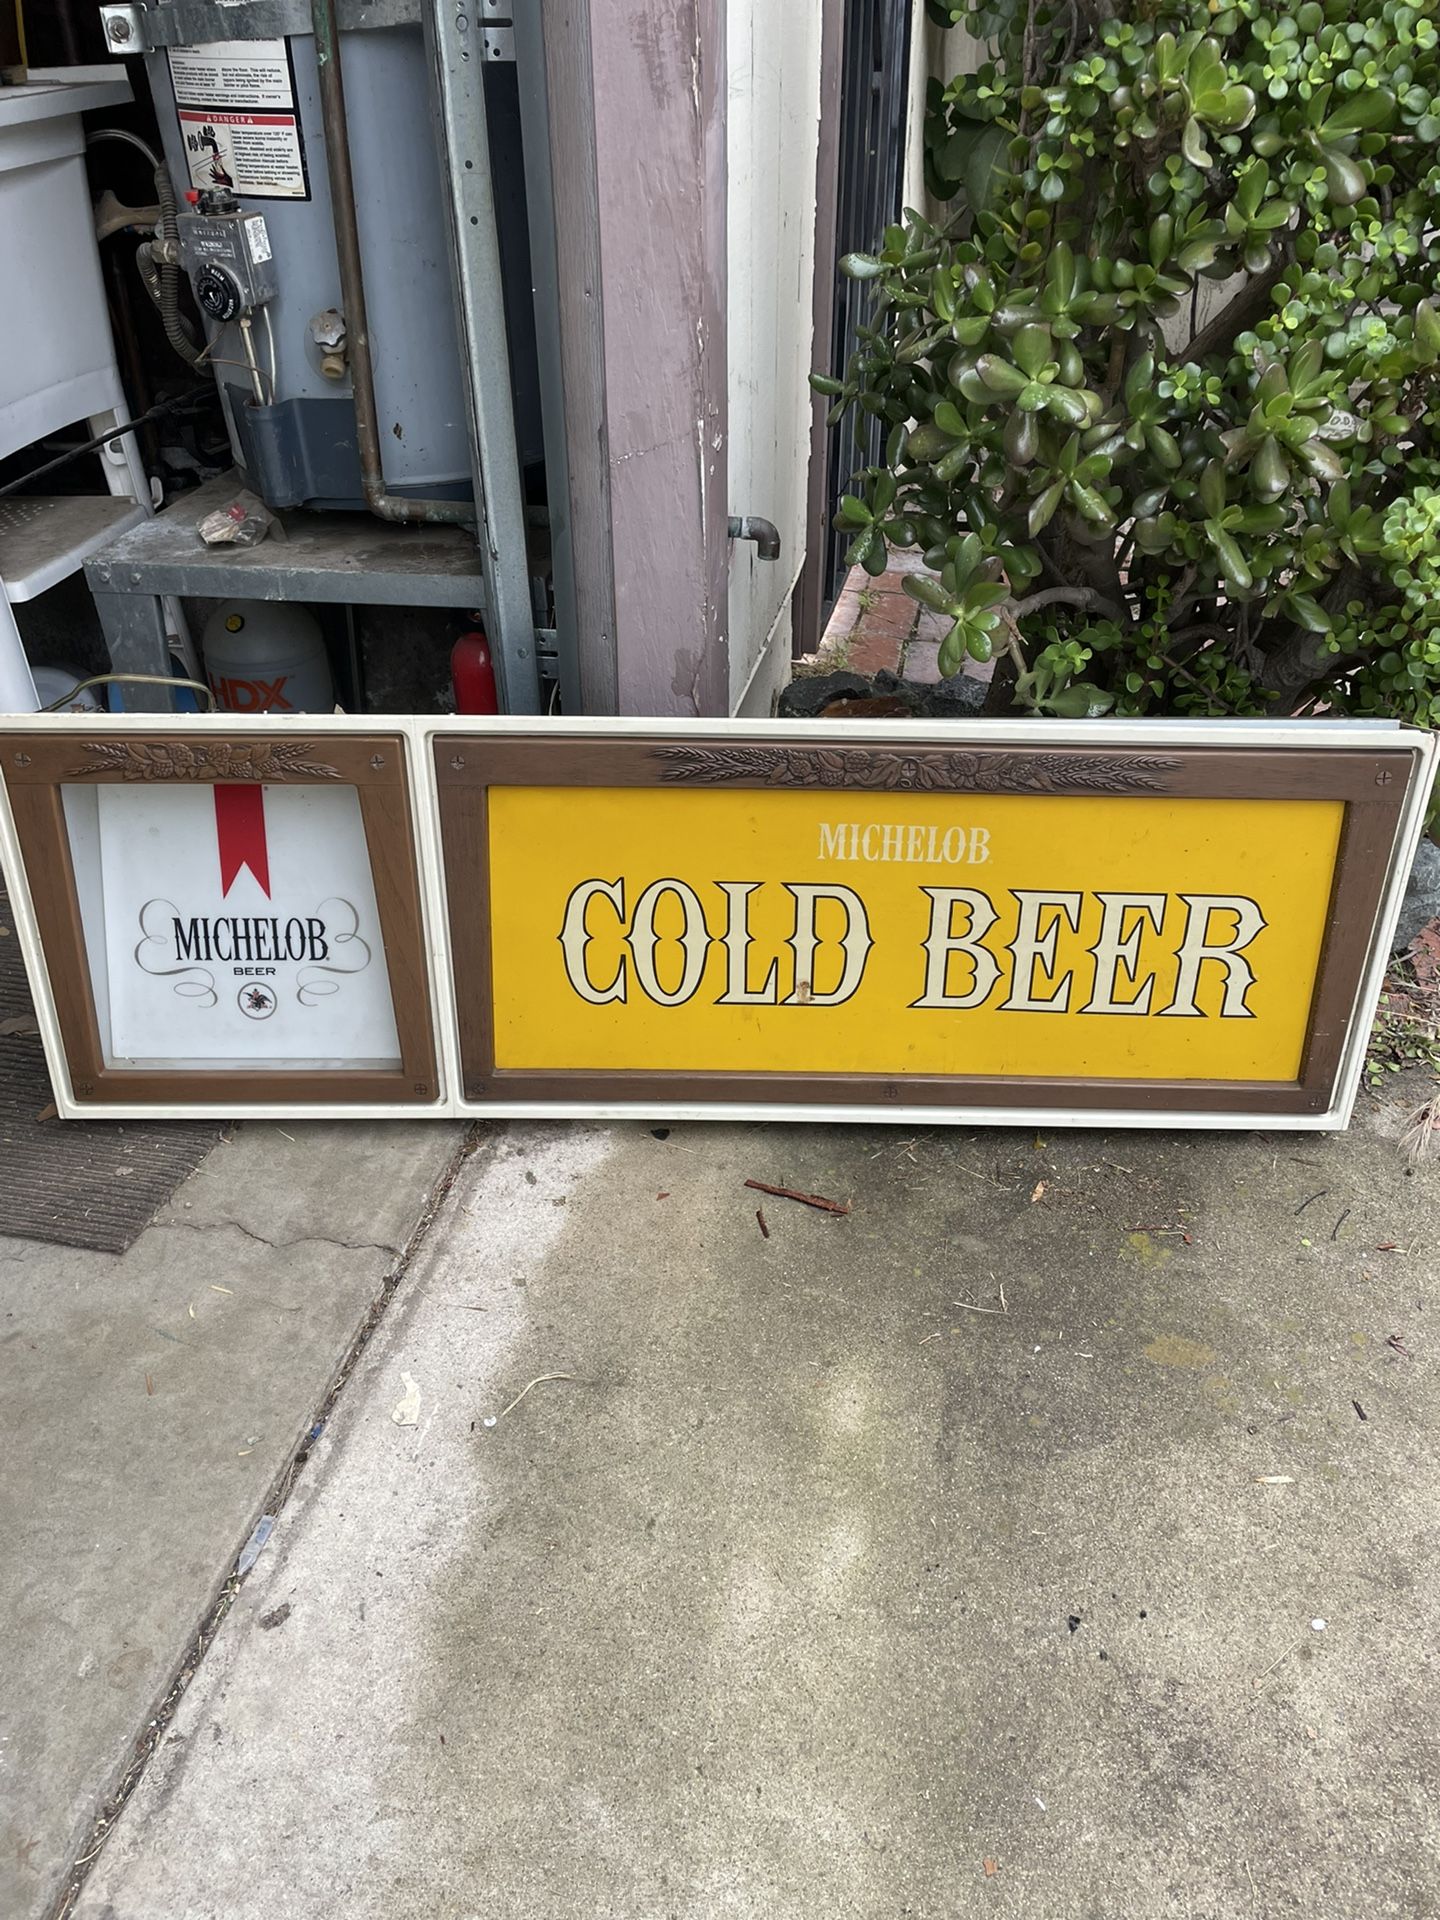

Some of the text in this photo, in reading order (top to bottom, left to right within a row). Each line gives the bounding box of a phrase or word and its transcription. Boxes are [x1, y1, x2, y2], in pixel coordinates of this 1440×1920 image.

[212, 115, 246, 124] DANGER
[208, 672, 294, 712] HDX
[816, 822, 990, 865] MICHELOB
[172, 916, 328, 962] MICHELOB
[556, 876, 1269, 1019] COLD BEER
[233, 966, 277, 976] BEER
